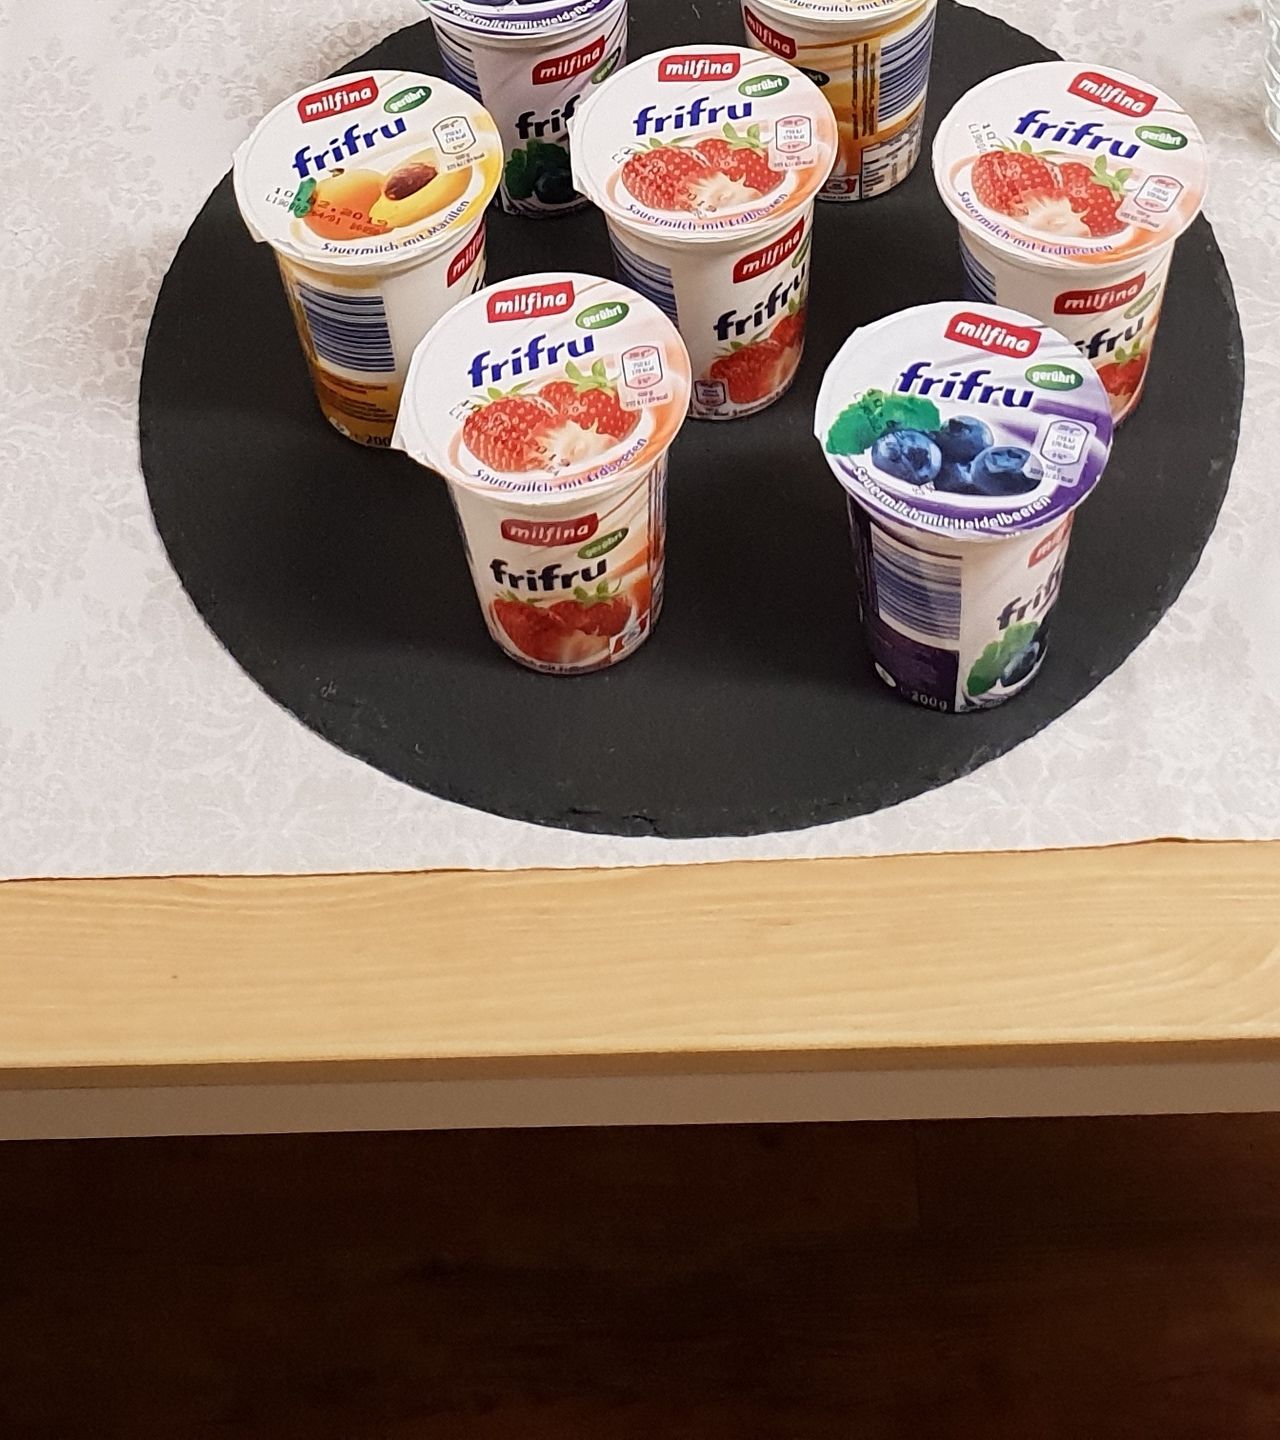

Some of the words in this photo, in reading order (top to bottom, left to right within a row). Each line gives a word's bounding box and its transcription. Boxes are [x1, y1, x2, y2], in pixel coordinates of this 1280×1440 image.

[857, 0, 879, 11] mit
[746, 14, 791, 55] milfina
[540, 47, 600, 78] milfina
[665, 58, 734, 80] milfina
[305, 87, 372, 116] milfina
[1077, 77, 1147, 114] milfina
[633, 96, 752, 137] frifru
[1013, 109, 1141, 160] frifru
[292, 117, 407, 179] frifru
[321, 241, 399, 255] Sauermilch
[403, 233, 426, 248] mit
[427, 200, 470, 242] Marillen
[626, 203, 698, 231] Sauermilch
[701, 219, 725, 231] mit
[957, 191, 1011, 240] Sauermilch
[1013, 236, 1038, 250] mit
[742, 230, 801, 275] milfina
[494, 292, 567, 319] milfina
[582, 305, 623, 326] gerührt
[713, 262, 806, 341] frifru
[1064, 283, 1139, 312] milfina
[954, 320, 1030, 353] milfina
[467, 333, 595, 388] frifru
[1032, 370, 1076, 386] gerührt
[898, 361, 1035, 408] frifru
[473, 469, 553, 492] Sauermilch
[587, 437, 647, 482] Erdbeeren
[852, 466, 920, 520] Sauermilch
[953, 494, 1051, 529] Heidelbeeren
[510, 524, 589, 543] milfina
[489, 558, 607, 592] frifru
